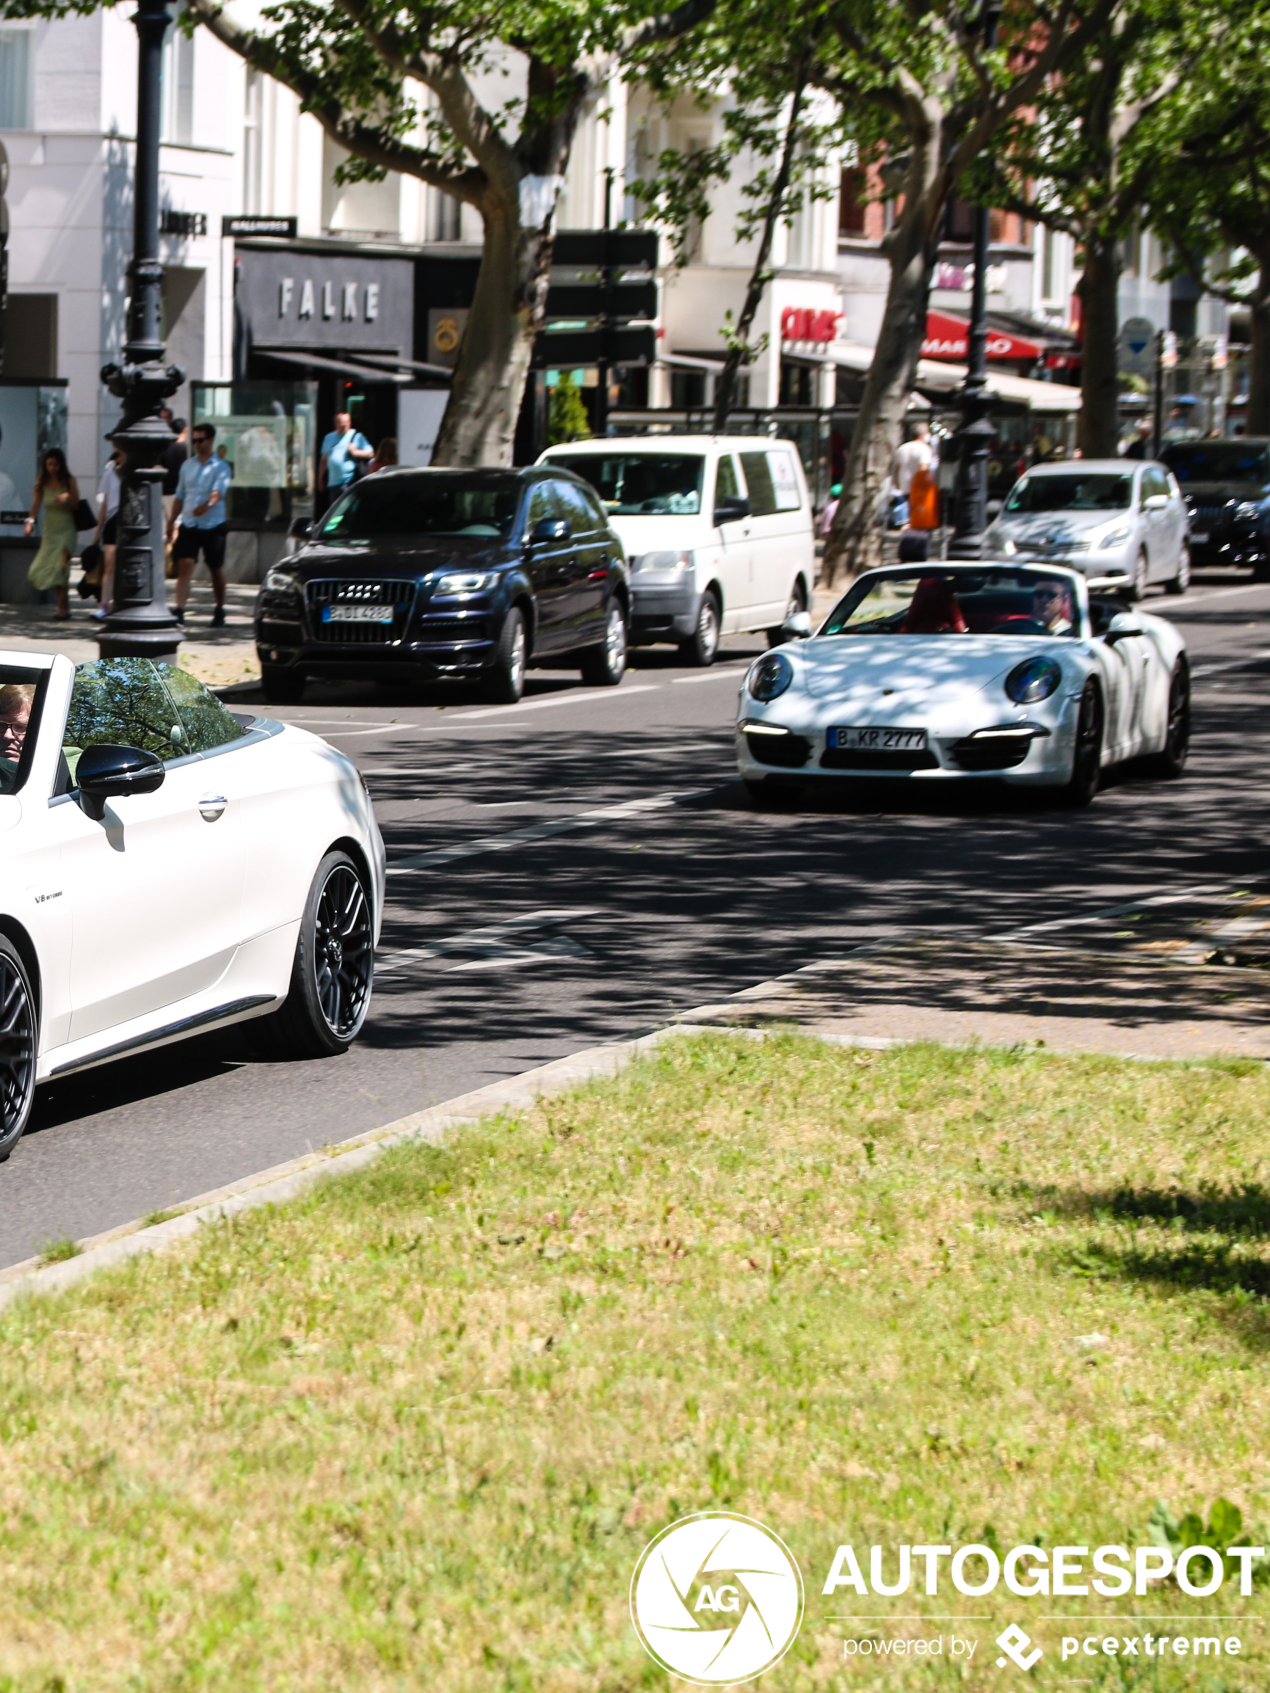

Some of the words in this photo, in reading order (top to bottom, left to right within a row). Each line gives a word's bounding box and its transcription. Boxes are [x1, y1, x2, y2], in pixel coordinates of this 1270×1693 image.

[279, 277, 380, 321] FALKE
[836, 730, 848, 747] B
[858, 730, 880, 748] KR
[883, 730, 925, 748] 2777
[35, 894, 46, 904] V8
